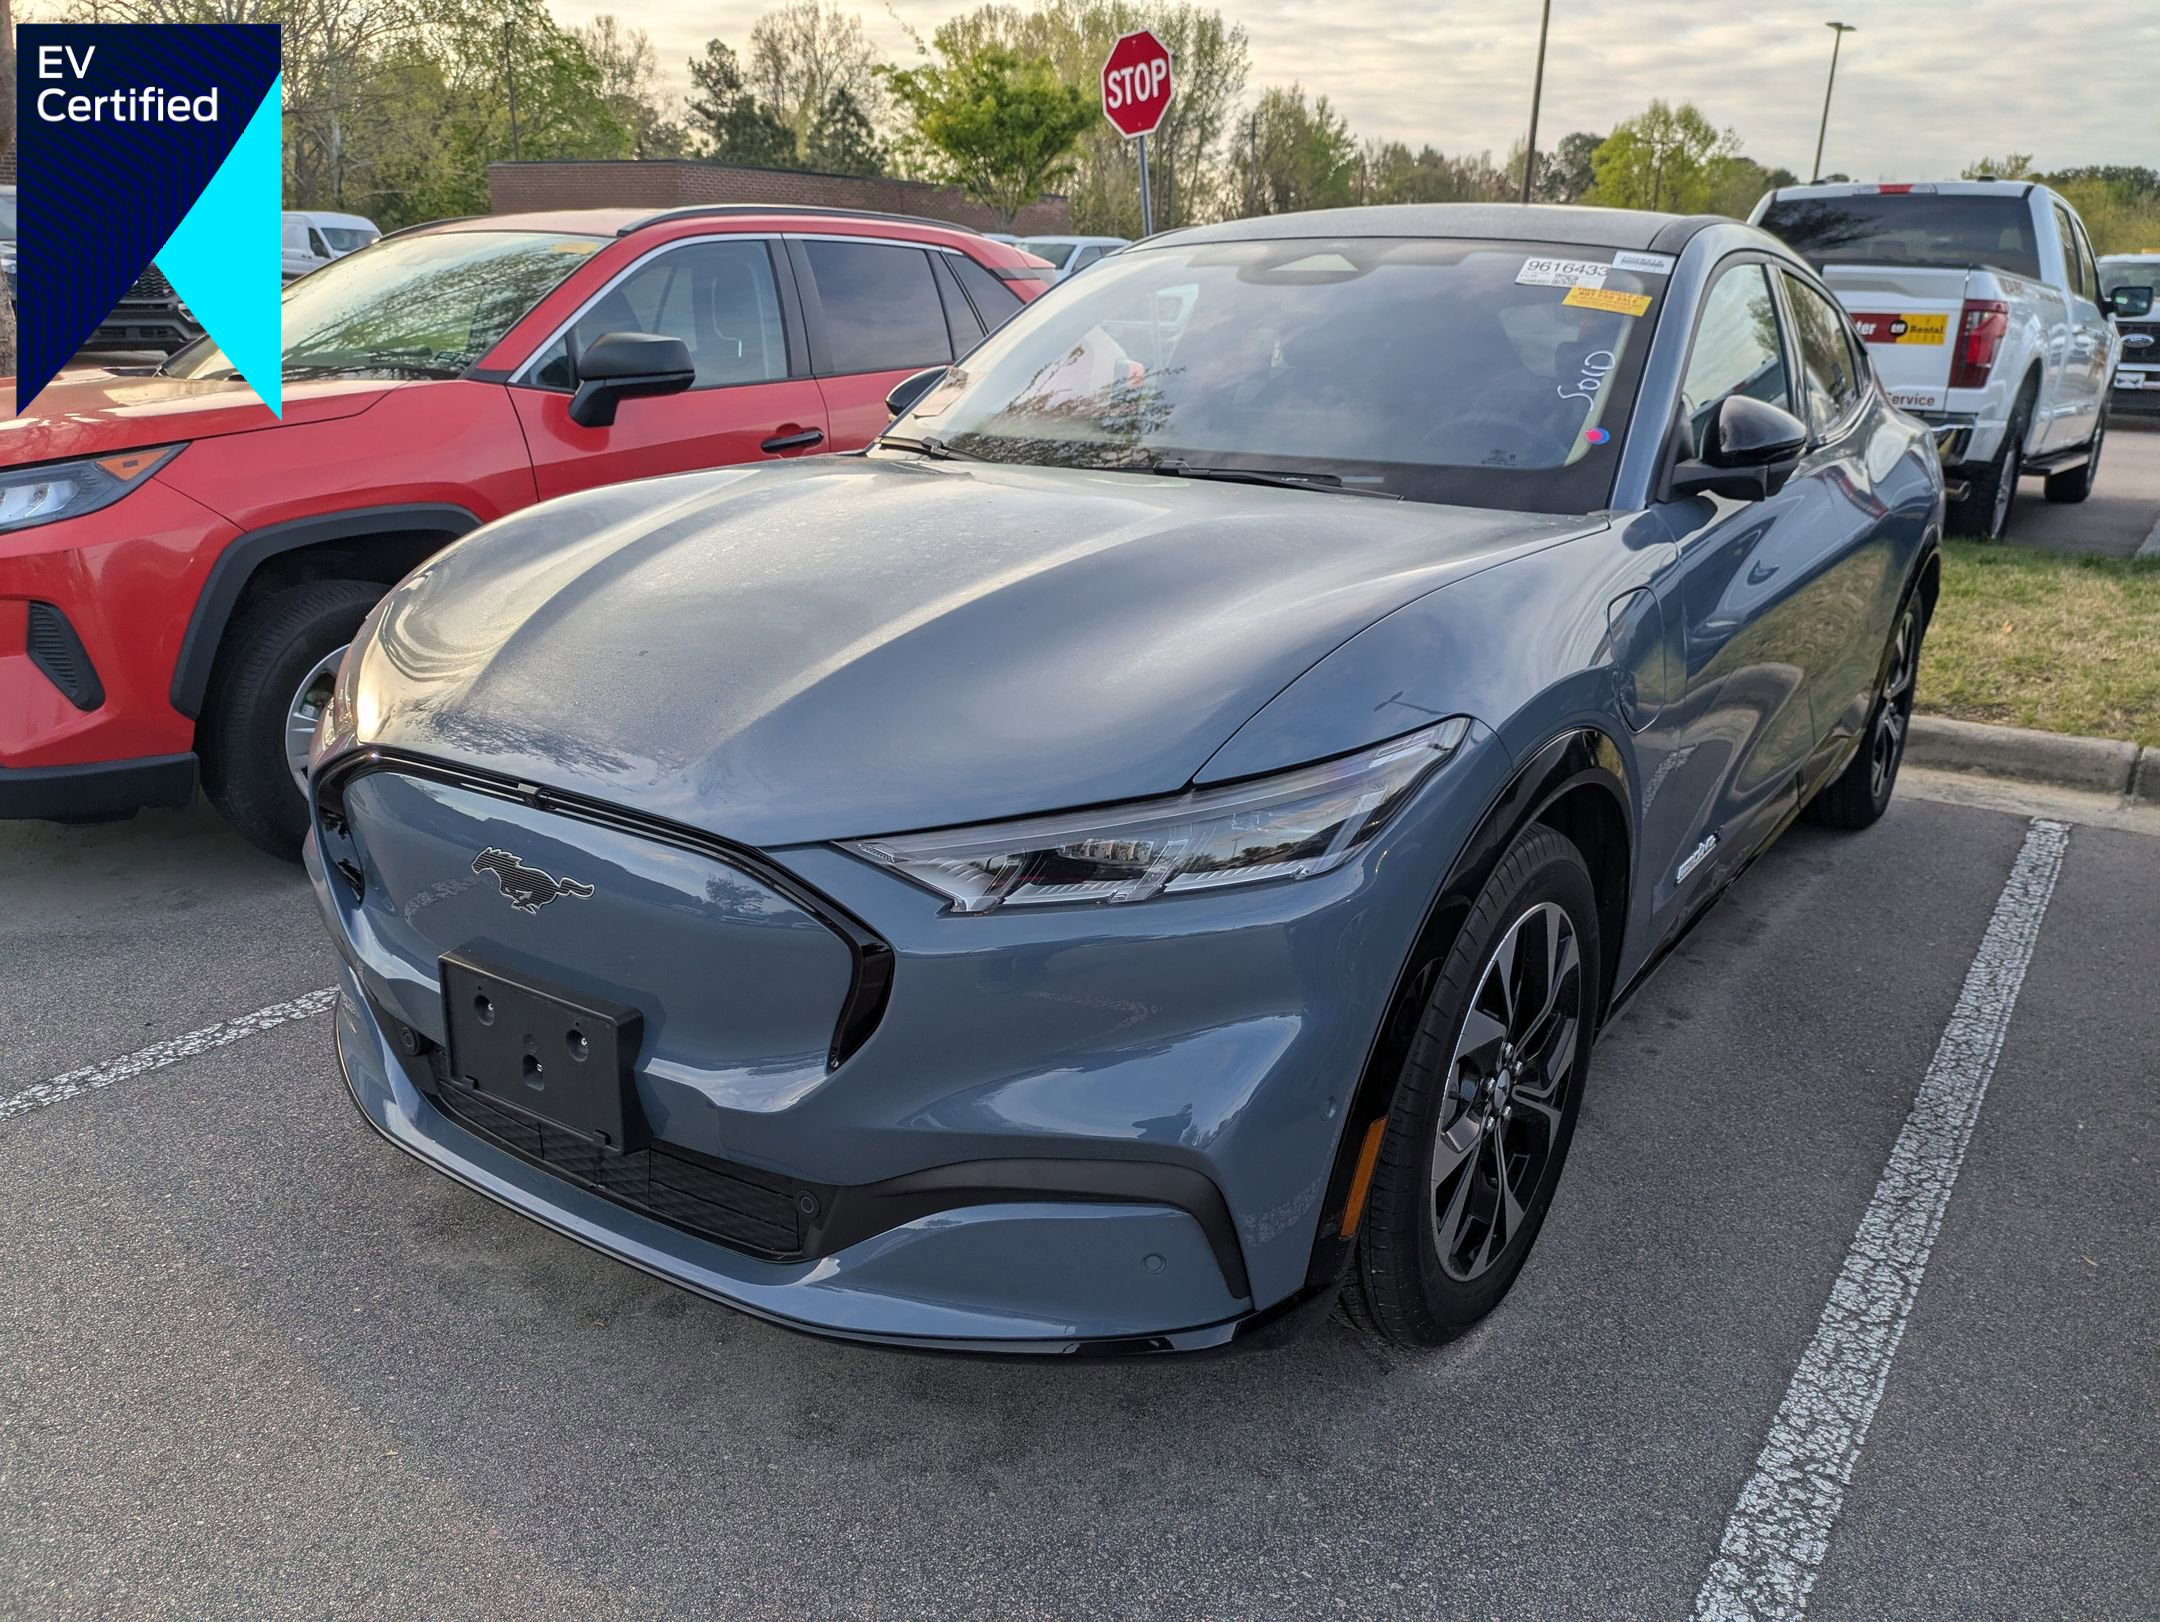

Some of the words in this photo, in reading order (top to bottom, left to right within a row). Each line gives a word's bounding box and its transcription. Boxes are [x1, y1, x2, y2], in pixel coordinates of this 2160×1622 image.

[1107, 58, 1167, 109] STOP
[1856, 320, 1876, 335] ter
[1910, 325, 1944, 334] Rental
[1887, 392, 1935, 406] ervice
